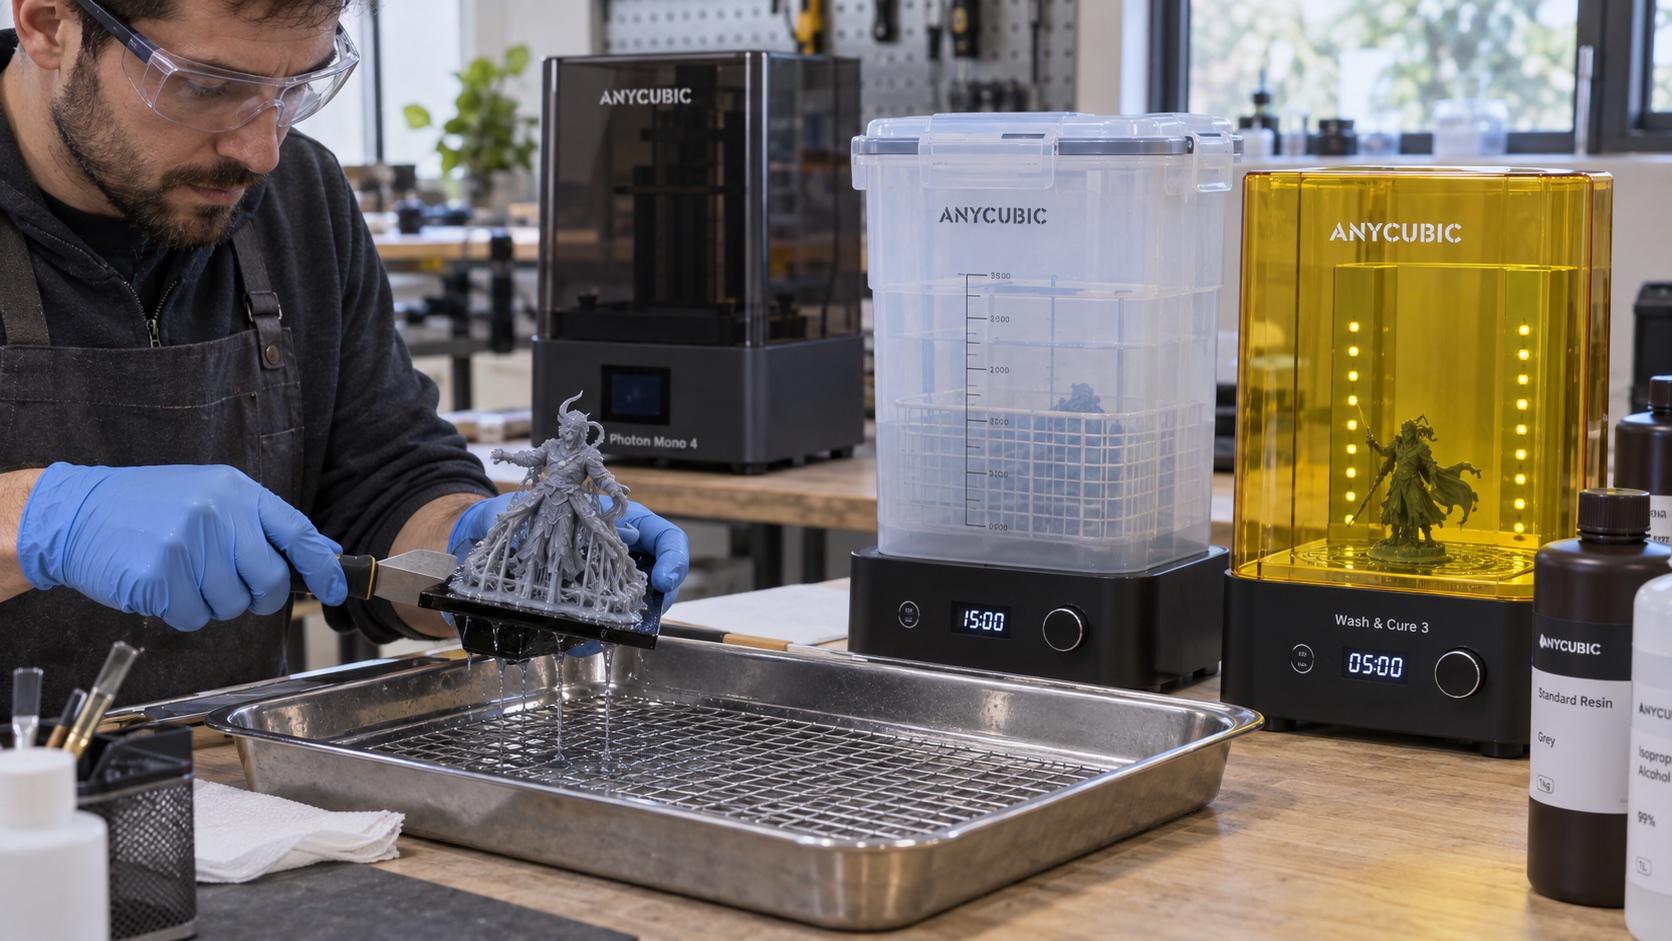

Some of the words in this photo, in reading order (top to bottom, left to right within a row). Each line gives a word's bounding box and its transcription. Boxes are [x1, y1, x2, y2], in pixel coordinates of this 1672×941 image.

[599, 87, 692, 105] ANYCUBIC
[939, 206, 1047, 225] ANYCUBIC
[1329, 222, 1462, 243] ANYCUBIC
[609, 433, 651, 446] Photon
[653, 436, 687, 449] Mono
[690, 438, 698, 449] 4
[963, 610, 1005, 632] 15:00
[1335, 614, 1370, 628] Wash
[1373, 617, 1383, 629] &
[1386, 618, 1418, 633] Cure
[1421, 622, 1430, 634] 3
[1348, 653, 1404, 678] 05:00
[1538, 687, 1577, 706] Standard
[1580, 695, 1613, 709] Resin
[1538, 731, 1556, 748] Grey
[1638, 764, 1671, 784] Alcohol
[1637, 810, 1656, 828] 99%
